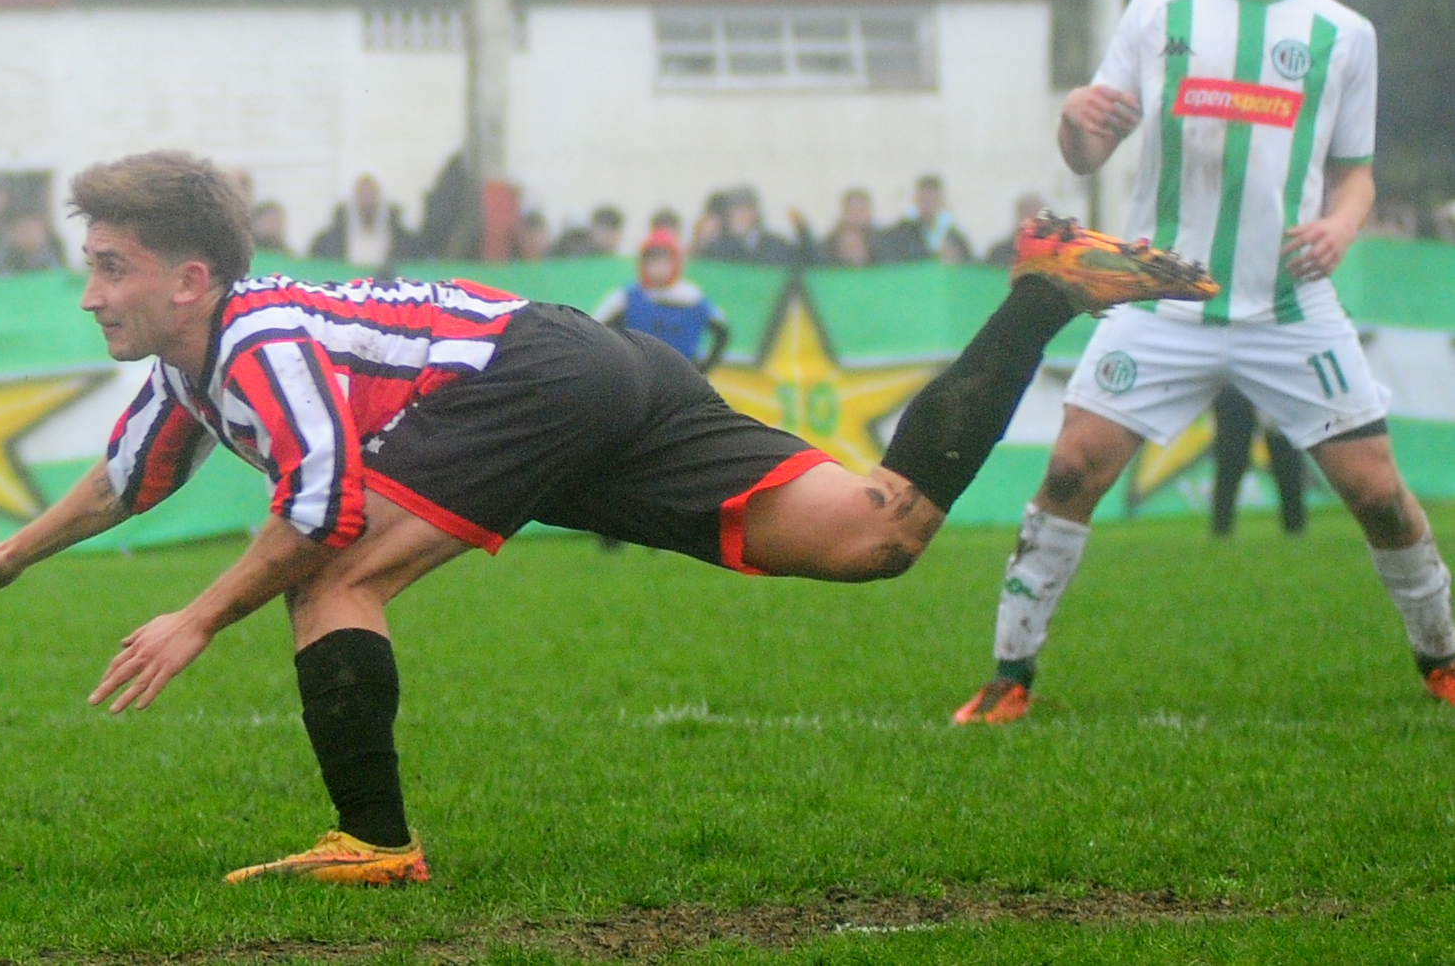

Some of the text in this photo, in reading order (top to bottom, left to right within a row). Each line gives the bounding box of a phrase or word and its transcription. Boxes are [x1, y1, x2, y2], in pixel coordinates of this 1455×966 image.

[1183, 88, 1294, 119] opensports
[1307, 348, 1349, 400] 11
[776, 382, 842, 436] 10
